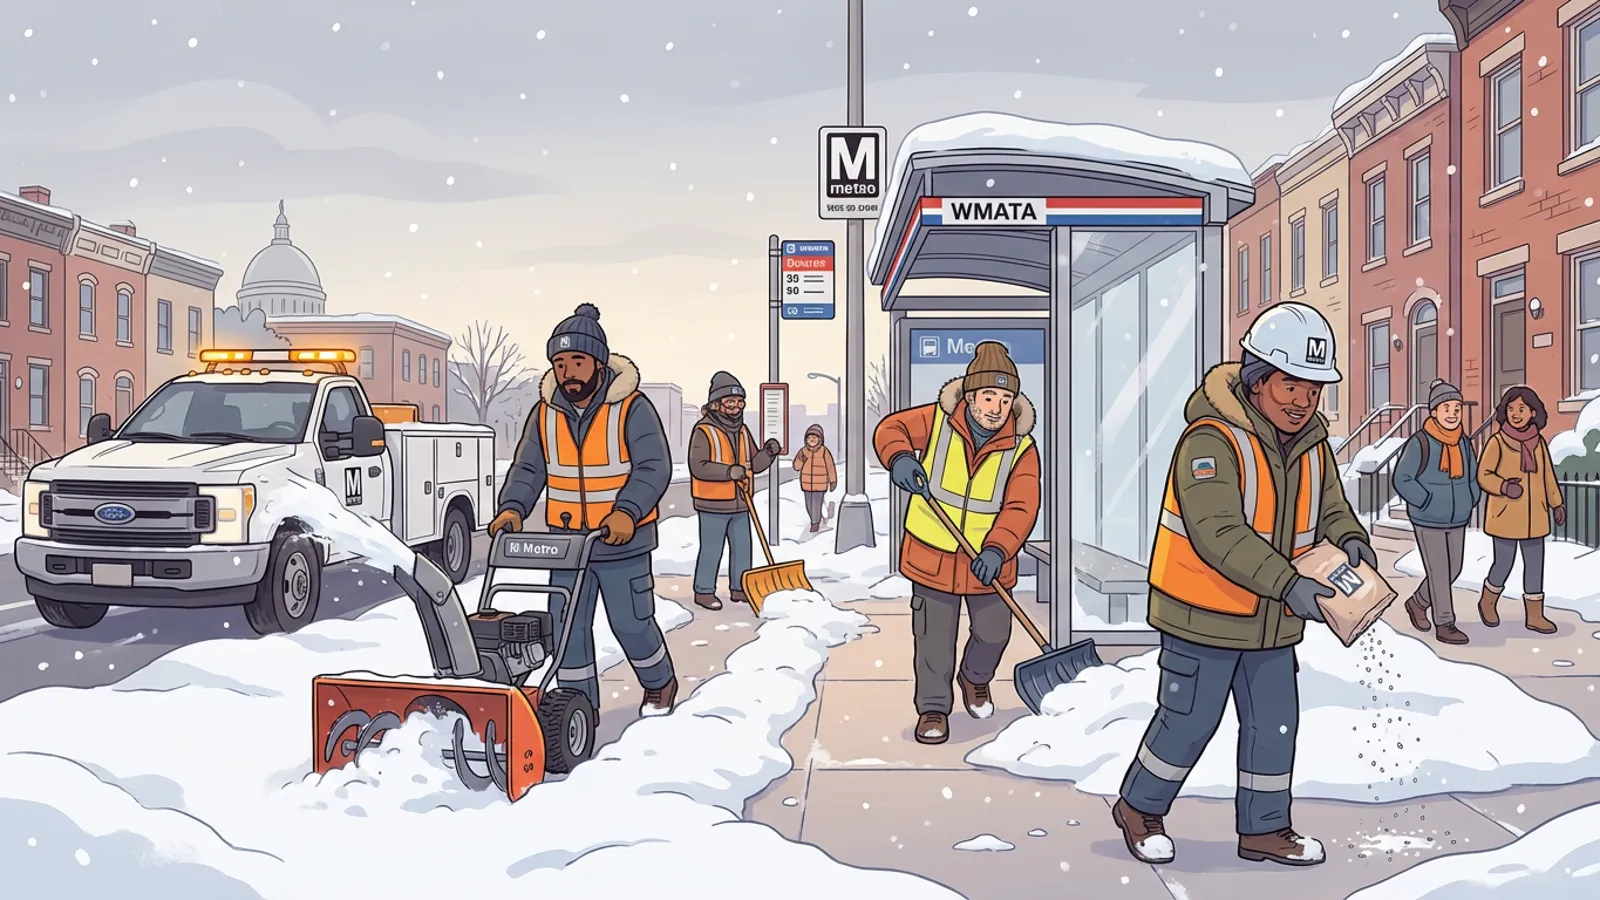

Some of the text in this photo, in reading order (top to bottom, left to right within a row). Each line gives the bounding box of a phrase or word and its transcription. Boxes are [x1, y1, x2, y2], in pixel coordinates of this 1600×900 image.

[831, 136, 875, 180] M
[951, 202, 1037, 220] WMATA
[1308, 338, 1326, 358] M
[346, 469, 361, 496] M
